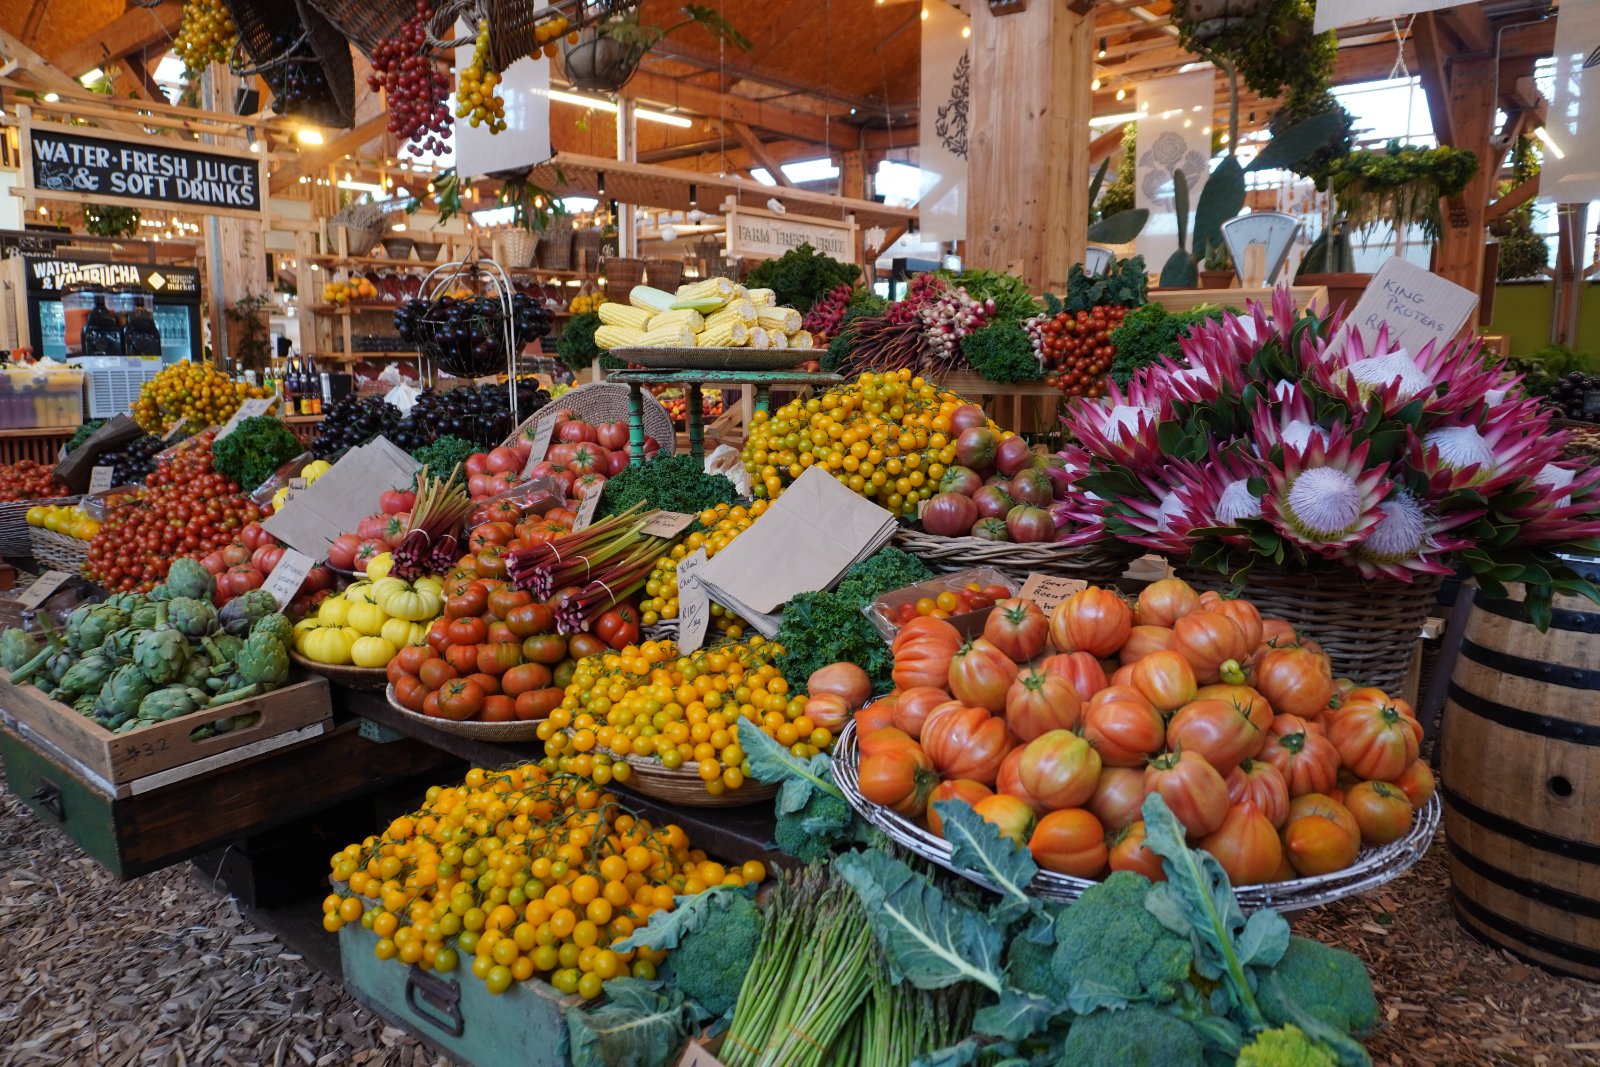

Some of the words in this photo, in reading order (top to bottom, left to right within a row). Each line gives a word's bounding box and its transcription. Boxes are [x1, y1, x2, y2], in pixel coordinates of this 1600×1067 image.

[120, 148, 188, 179] FRESH
[195, 160, 254, 186] JUICE
[74, 167, 99, 191] &
[110, 171, 169, 198] SOFT
[176, 177, 255, 206] DRINKS
[737, 224, 770, 243] FARM
[776, 230, 811, 248] FRESH
[815, 236, 846, 254] FRUIT
[42, 277, 53, 290] &
[1383, 279, 1425, 304] KING
[1386, 295, 1445, 332] PROTEAS
